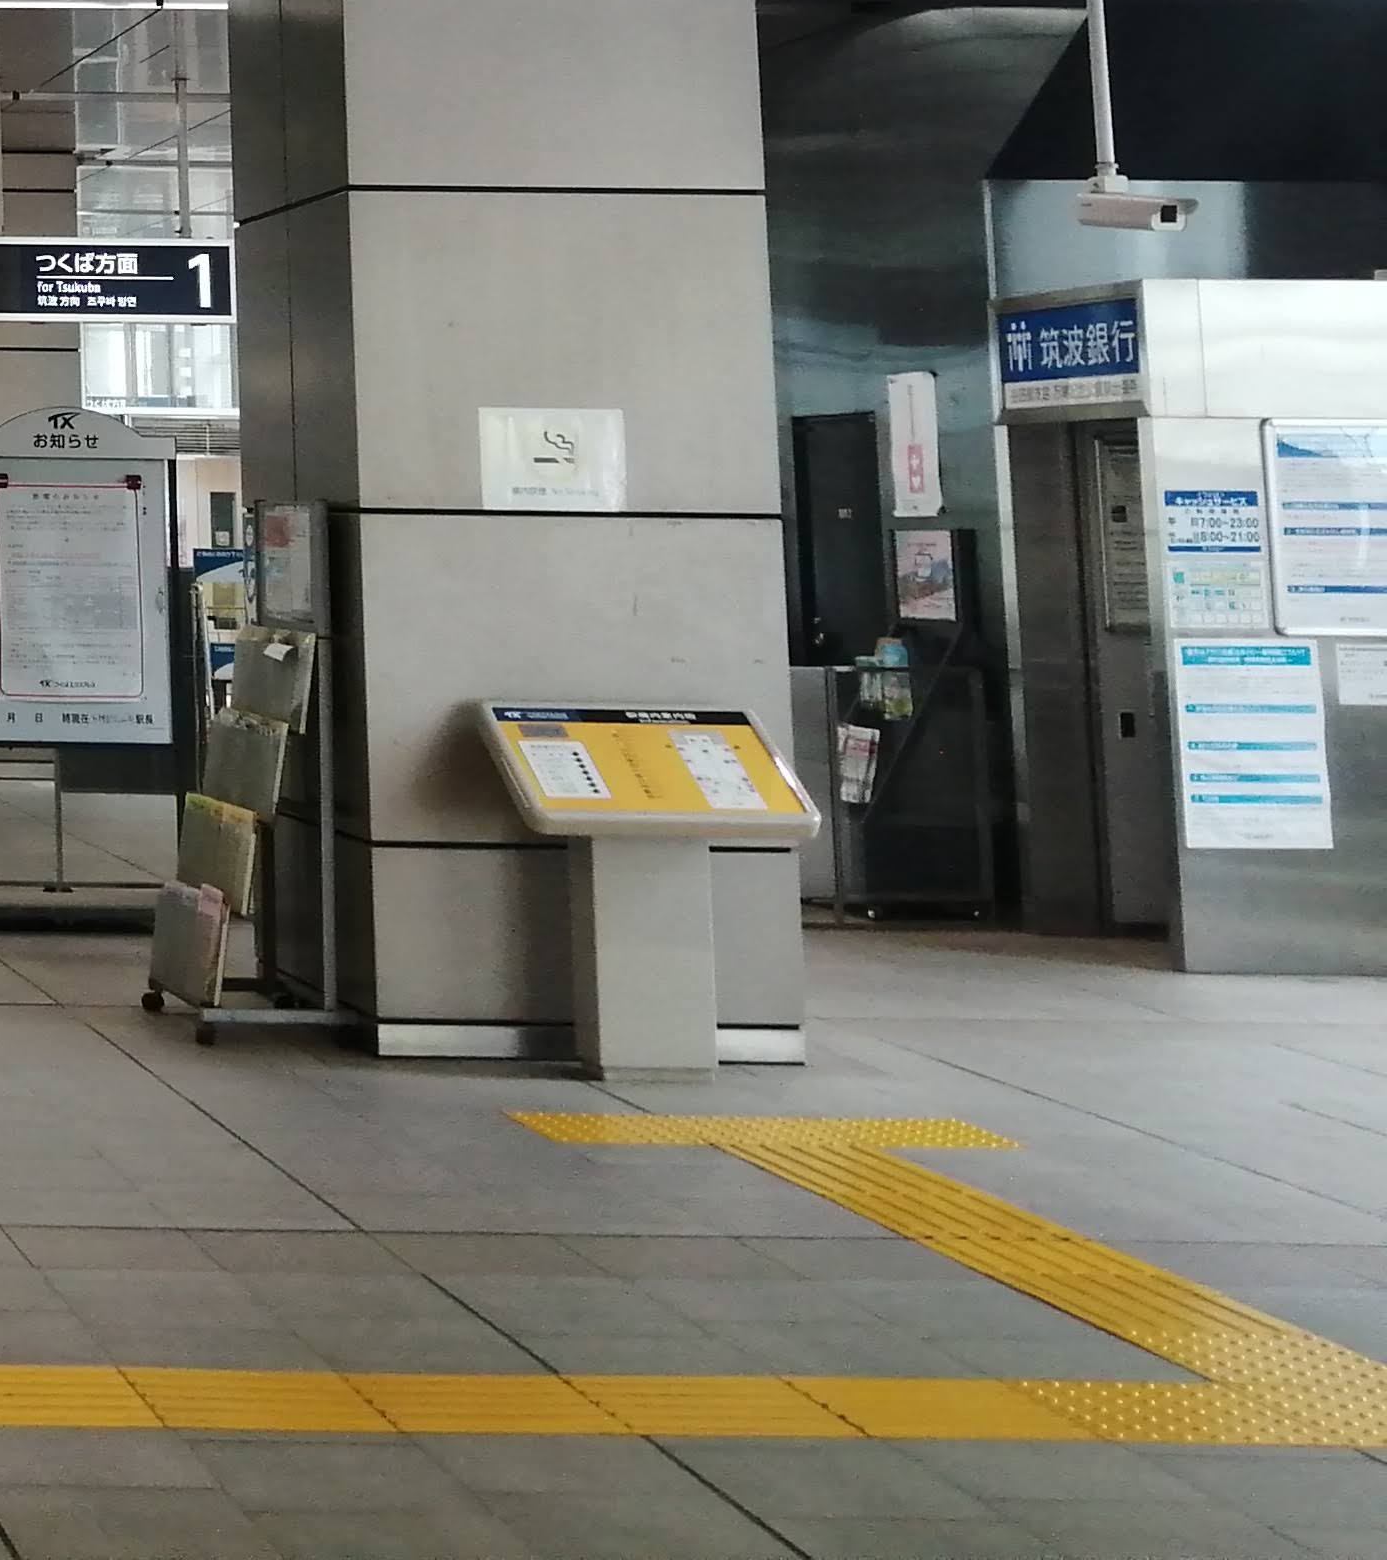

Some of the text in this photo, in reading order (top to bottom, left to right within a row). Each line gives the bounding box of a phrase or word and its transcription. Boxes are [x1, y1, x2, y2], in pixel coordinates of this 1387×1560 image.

[35, 252, 138, 275] つくば方面
[37, 281, 101, 293] for Tsukuba
[187, 253, 212, 309] 1
[1039, 320, 1135, 368] 筑波銀行
[48, 412, 81, 430] TX
[33, 433, 99, 449] お知らせ
